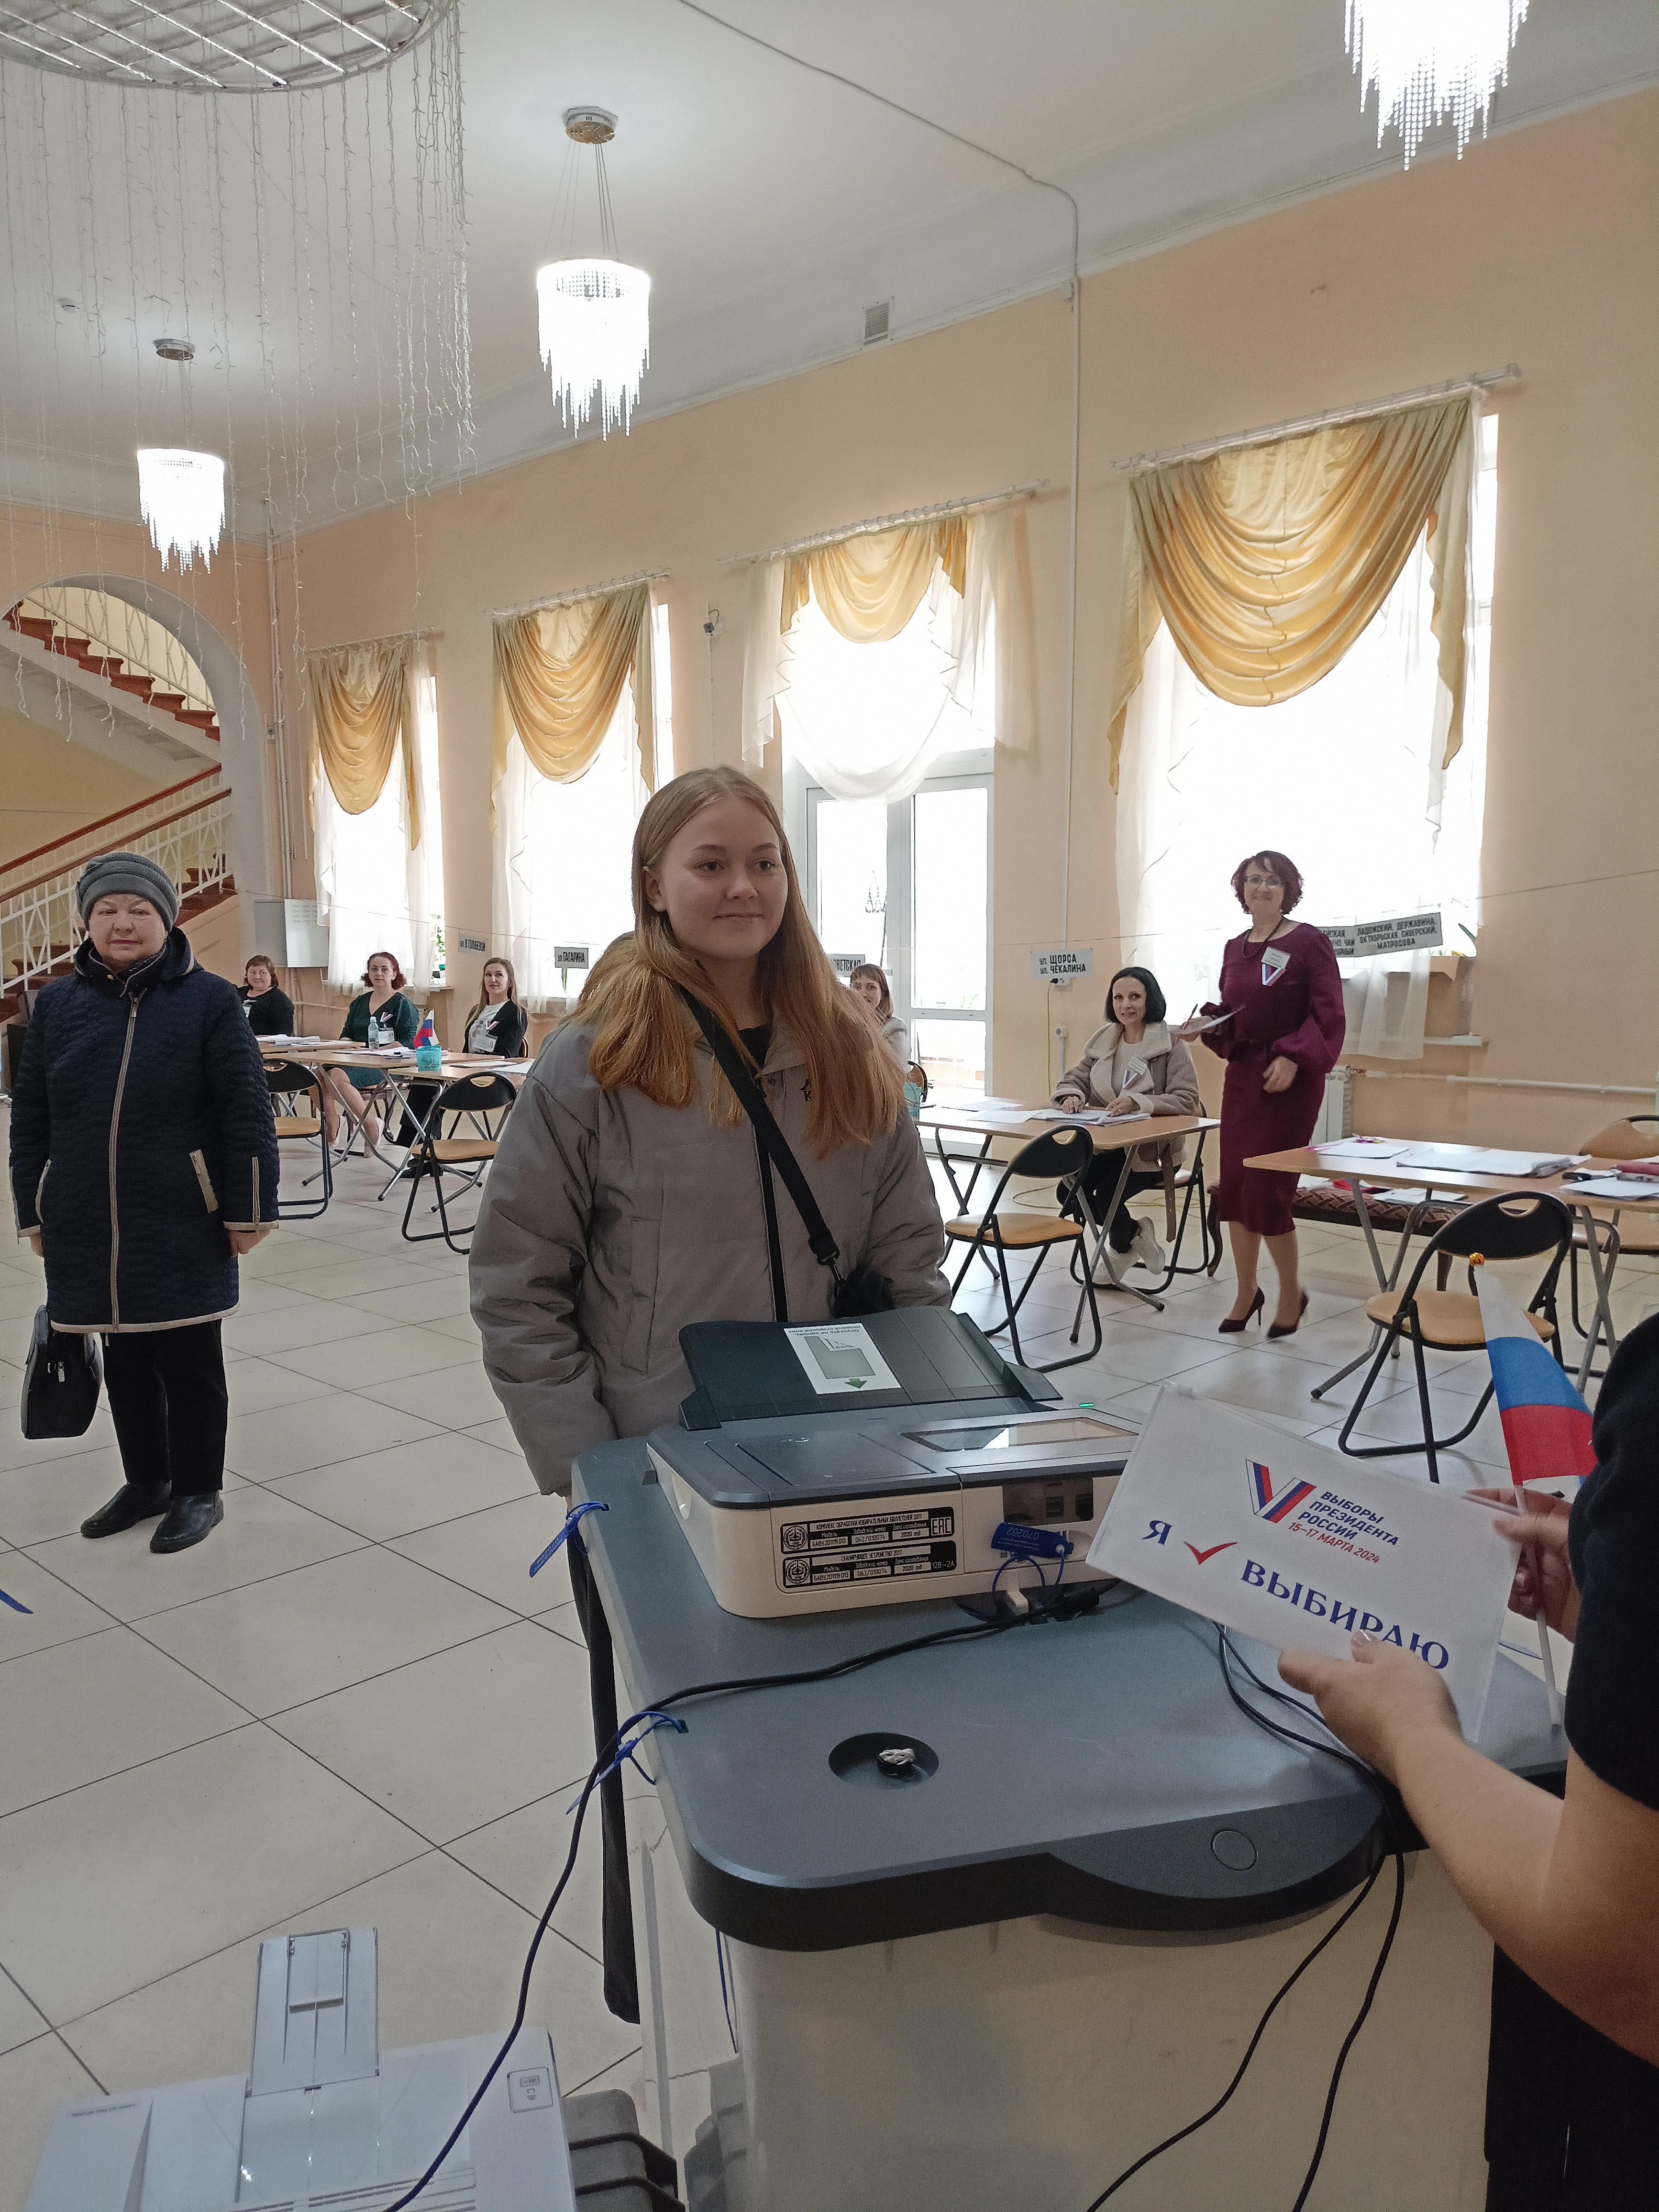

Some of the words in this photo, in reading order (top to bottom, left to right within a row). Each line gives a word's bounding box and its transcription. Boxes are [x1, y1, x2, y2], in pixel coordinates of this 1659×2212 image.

[1377, 938, 1416, 949] МАТРОСОВА
[563, 952, 585, 962] ГАГАРИНА
[1050, 954, 1077, 965] ЩОРСА
[1050, 963, 1086, 973] ЧЕКАЛИНА
[1320, 1491, 1384, 1524] ВЫБОРЫ
[1006, 1527, 1040, 1540] 070262
[1142, 1519, 1173, 1545] Я
[1297, 1511, 1358, 1540] РОССИИ
[1309, 1501, 1399, 1546] ПРЕЗИДЕНТА
[1316, 1533, 1354, 1553] МАРТА
[1353, 1548, 1380, 1563] 2024
[1240, 1559, 1449, 1670] ВЫБИРАЮ
